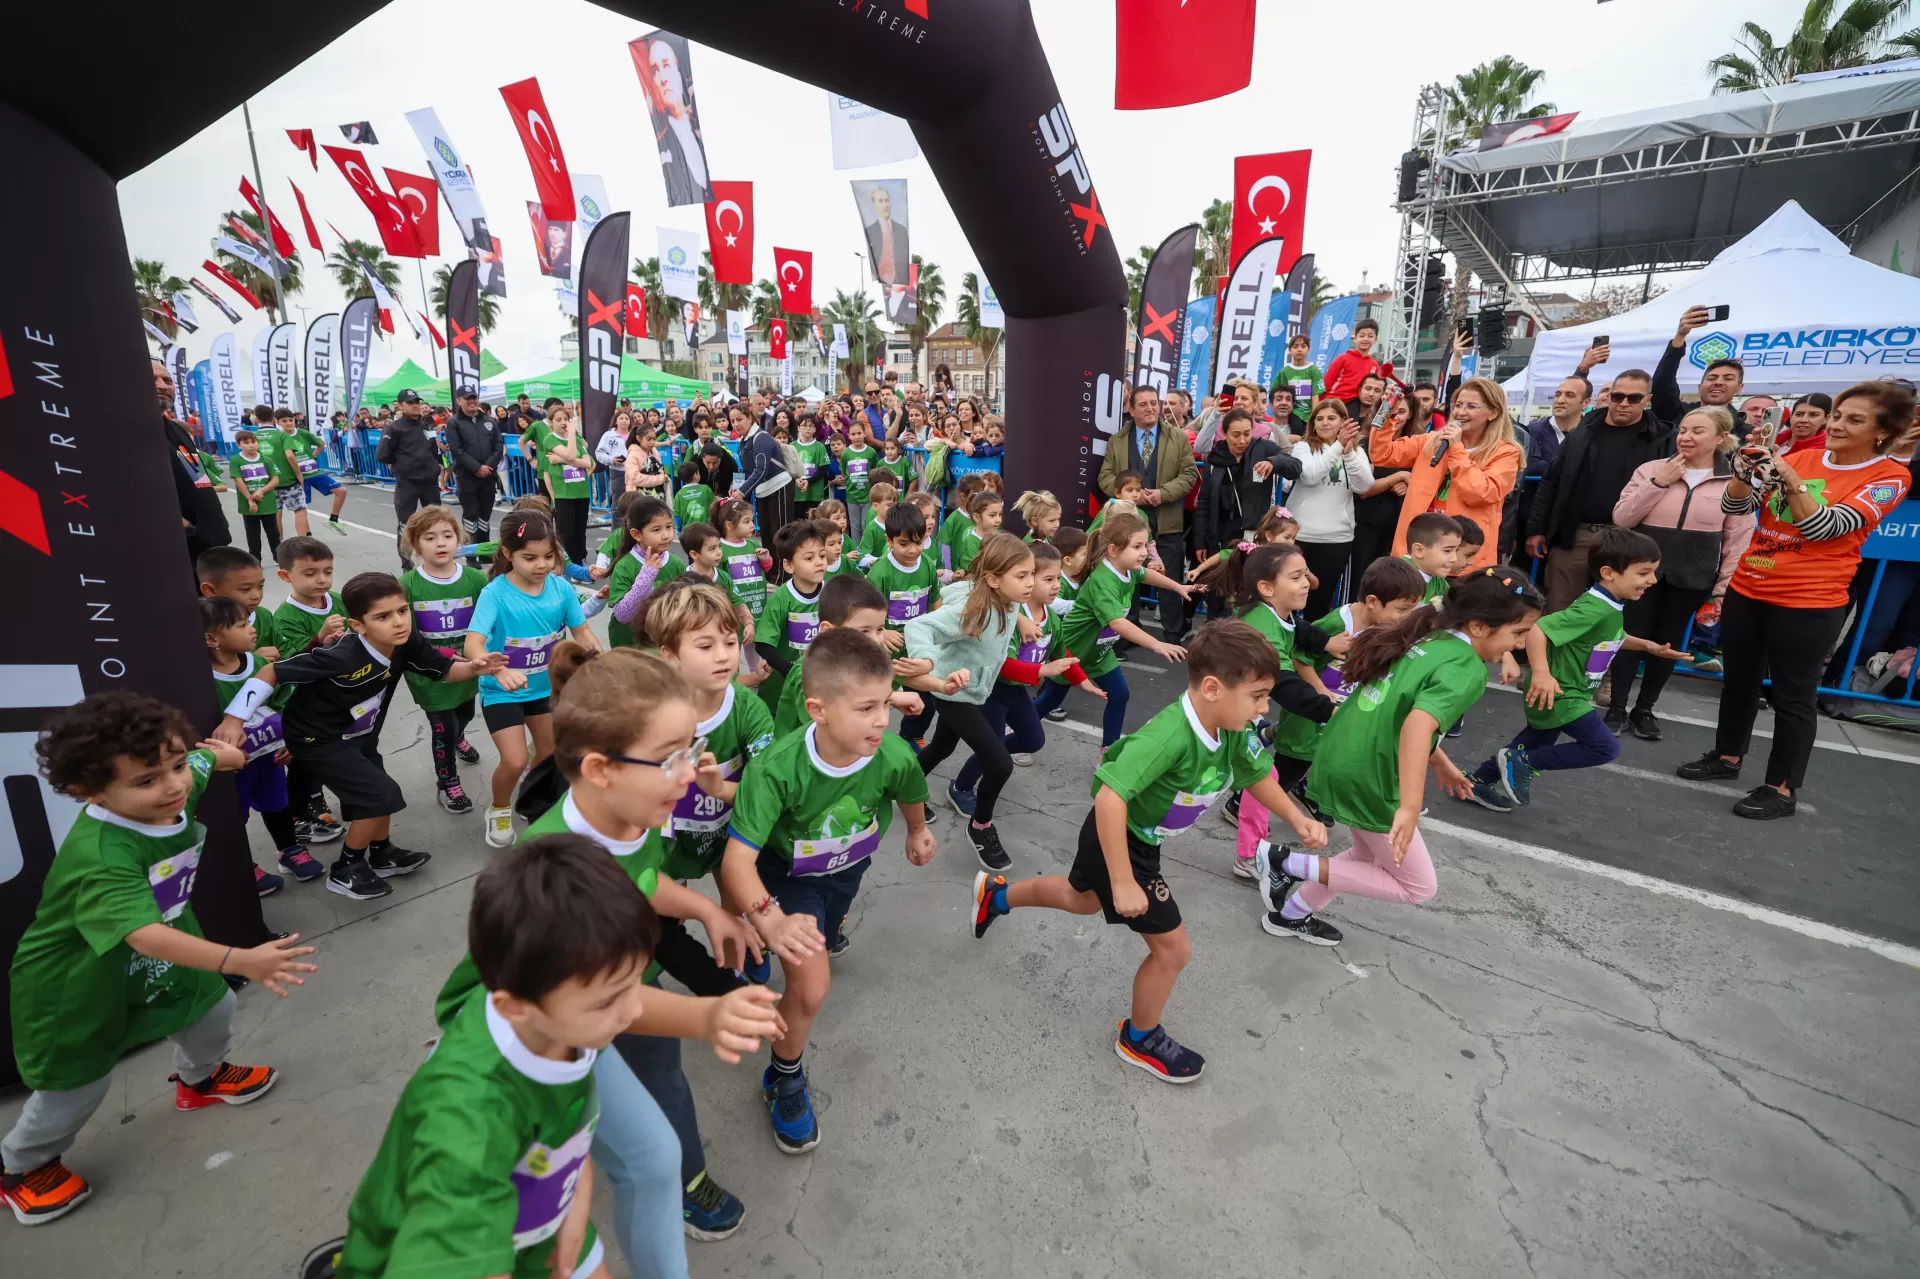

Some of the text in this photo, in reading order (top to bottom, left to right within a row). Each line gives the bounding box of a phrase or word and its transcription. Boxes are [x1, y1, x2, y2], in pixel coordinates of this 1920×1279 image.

[1038, 102, 1107, 250] SPX
[1064, 209, 1087, 256] EXTREME
[587, 288, 623, 396] SPX
[1139, 301, 1178, 400] SPX
[1226, 271, 1264, 382] RELL
[276, 339, 289, 410] ERRELL
[1081, 370, 1092, 424] SPORT
[24, 326, 95, 537] EXTREME
[1079, 435, 1089, 486] POINT
[1873, 522, 1920, 538] ABIT
[80, 573, 126, 678] OINT
[439, 616, 455, 629] 19
[804, 628, 821, 642] 29
[525, 652, 545, 666] 150
[247, 725, 277, 748] 141
[826, 851, 850, 870] 65
